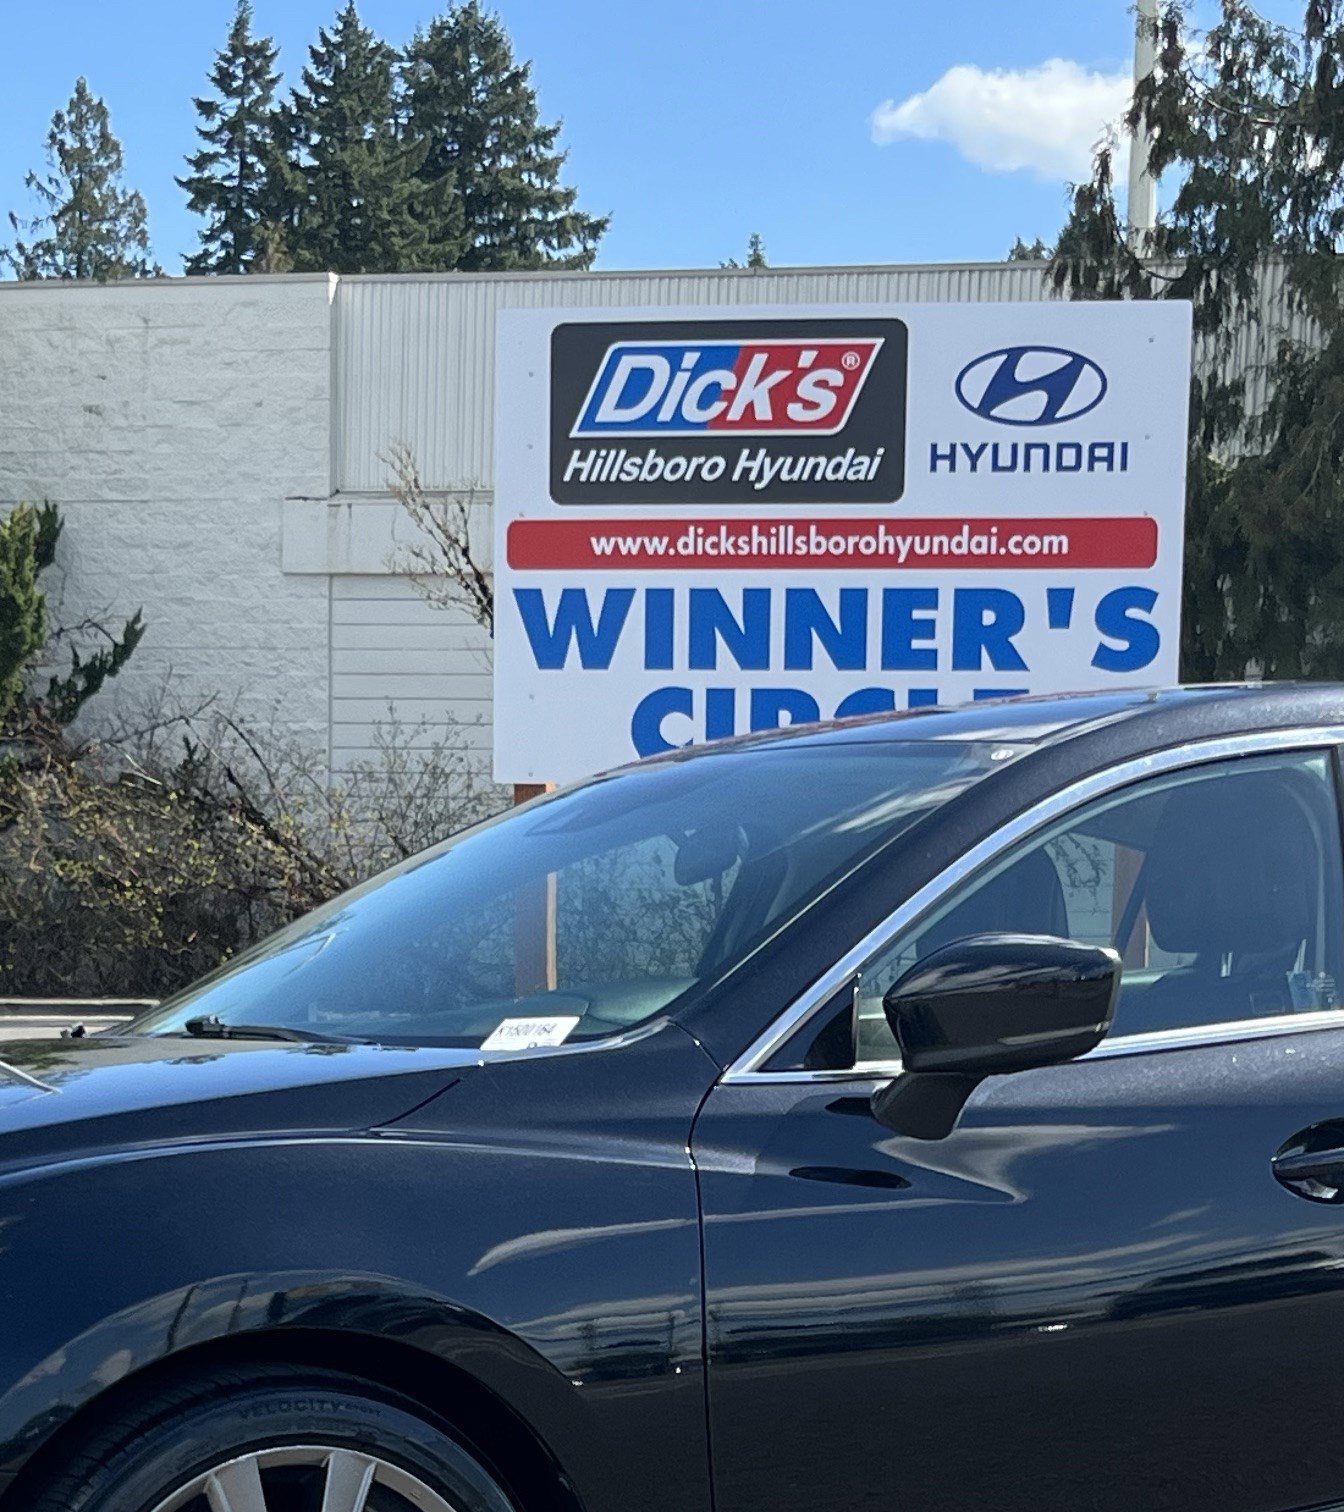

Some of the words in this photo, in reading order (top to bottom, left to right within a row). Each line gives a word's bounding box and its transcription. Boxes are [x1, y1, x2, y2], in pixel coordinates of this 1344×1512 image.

[594, 350, 845, 424] Dick's
[563, 449, 726, 482] Hillsboro
[731, 448, 885, 490] Hyundai
[930, 441, 1129, 473] HYUNDAI
[590, 524, 1069, 563] www.dickshillsborohyundai.com
[512, 585, 1161, 673] WINNER'S
